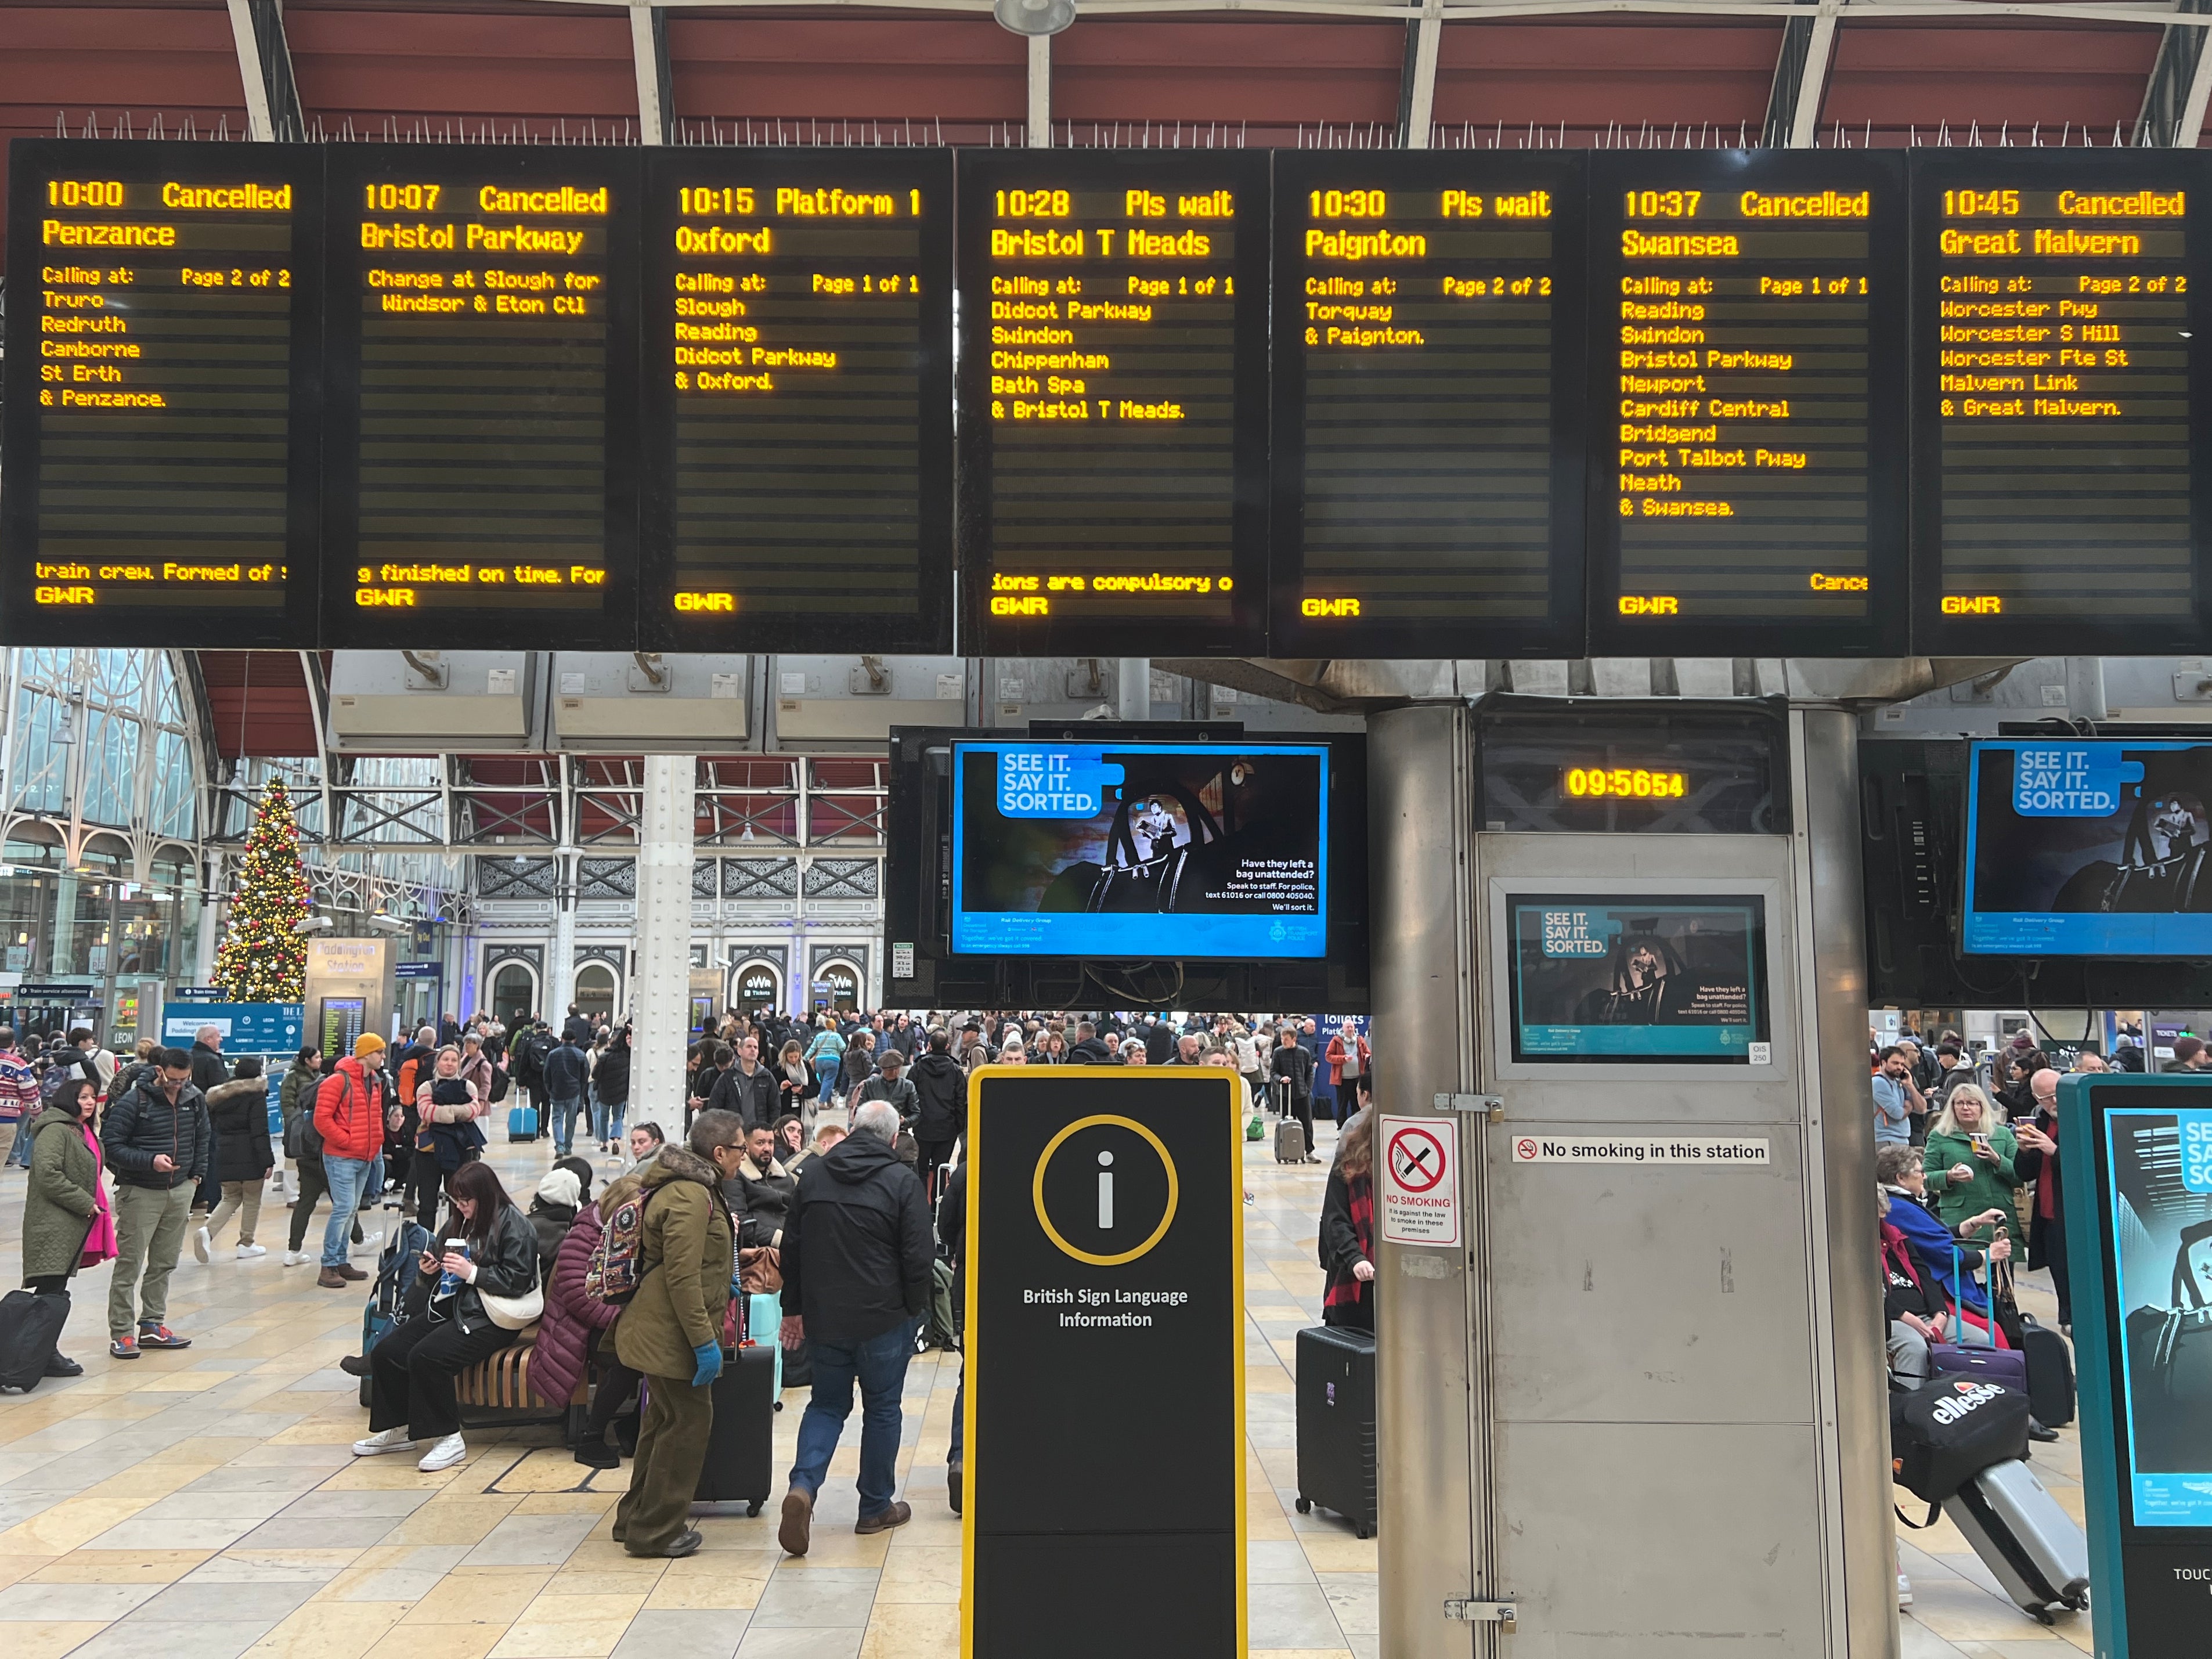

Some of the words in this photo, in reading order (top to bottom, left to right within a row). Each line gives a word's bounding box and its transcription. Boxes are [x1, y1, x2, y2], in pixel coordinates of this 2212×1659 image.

[49, 181, 124, 207] 10:00
[163, 182, 291, 209] Cancelled
[366, 185, 440, 210] 10:07
[480, 186, 607, 214] Cancelled
[680, 188, 755, 215] 10:15
[777, 188, 894, 216] Platform
[910, 189, 919, 215] 1
[997, 190, 1070, 217] 10:28
[1127, 190, 1166, 217] Pls
[1179, 190, 1234, 217] wait
[1945, 190, 2019, 216] 10:45
[1310, 190, 1385, 218] 10:30
[1442, 190, 1482, 218] Pls
[1495, 191, 1551, 218] wait
[1627, 191, 1701, 217] 10:37
[1741, 191, 1869, 217] Cancelled
[2059, 191, 2185, 217] Cancelled
[43, 220, 175, 246] Penzance
[362, 223, 454, 249] Bristol
[467, 224, 583, 254] Parkway
[676, 226, 771, 254] Oxford
[1940, 229, 2021, 254] Great
[2034, 229, 2140, 255] Malvern
[992, 229, 1084, 257] Bristol
[1096, 229, 1114, 255] T
[1128, 229, 1210, 257] Meads
[1306, 230, 1426, 260] Paignton
[1622, 230, 1739, 257] Swansea
[42, 267, 100, 285] Calling
[108, 268, 133, 283] at:
[182, 268, 223, 287] Page
[232, 269, 242, 285] 2
[250, 270, 270, 286] of
[279, 269, 290, 287] 2
[369, 270, 443, 288] Change
[452, 271, 475, 288] at
[485, 271, 555, 291] Slough
[564, 272, 600, 290] for
[43, 291, 104, 308] Truro
[383, 294, 465, 312] Windsor
[474, 295, 488, 312] &
[496, 295, 546, 314] Eton
[1941, 301, 2050, 318] Worcester
[2059, 301, 2098, 318] Pwy
[42, 316, 125, 333] Redruth
[41, 341, 140, 357] Camborne
[41, 365, 63, 381] St
[73, 365, 121, 381] Erth
[1941, 374, 2025, 391] Malvern
[2034, 374, 2079, 391] Link
[1621, 400, 1699, 418] Cardiff
[1709, 399, 1789, 417] Central
[1621, 424, 1716, 443] Bridgend
[36, 562, 90, 579] train
[99, 567, 154, 579] crew.
[164, 563, 239, 580] Formed
[248, 564, 273, 580] of
[380, 564, 471, 582] finished
[478, 569, 505, 582] on
[514, 566, 562, 583] time.
[571, 567, 605, 583] For
[992, 574, 1039, 590] ions
[1047, 577, 1085, 590] are
[1093, 574, 1211, 593] compulsory
[1219, 577, 1233, 590] o
[35, 587, 94, 604] GWR
[1942, 597, 2000, 614] GWR
[1004, 754, 1043, 771] SEE
[1049, 755, 1070, 771] IT.
[2021, 752, 2061, 769] SEE
[2066, 752, 2089, 769] IT.
[1004, 773, 1043, 790] SAY
[1049, 774, 1070, 791] IT.
[2020, 771, 2061, 789] SAY
[2066, 772, 2088, 789] IT.
[1004, 793, 1096, 810] SORTED.
[2019, 791, 2115, 809] SORTED.
[1242, 859, 1265, 868] Have
[1266, 859, 1289, 870] they
[1289, 859, 1307, 868] left
[1236, 870, 1254, 880] bag
[1254, 870, 1315, 879] unattended?
[1226, 882, 1249, 890] Speak
[1291, 883, 1315, 892] police,
[1546, 913, 1570, 925] SEE
[1574, 913, 1588, 925] IT.
[1546, 926, 1571, 939] SAY
[1574, 926, 1588, 939] IT.
[1546, 940, 1605, 953] SORTED.
[327, 961, 365, 972] Station
[746, 975, 771, 989] GWR
[114, 1033, 133, 1044] LEON
[1543, 1142, 1566, 1157] No
[1572, 1143, 1644, 1160] smoking
[1650, 1144, 1665, 1157] in
[1669, 1144, 1701, 1158] this
[1706, 1144, 1764, 1158] station
[1387, 1194, 1398, 1204] NO
[1401, 1196, 1450, 1207] SMOKING
[1024, 1288, 1073, 1304] British
[1078, 1289, 1110, 1307] Sign
[1115, 1289, 1188, 1306] Language
[1060, 1312, 1152, 1327] Information
[1932, 1379, 2007, 1426] ellesse
[2173, 1568, 2212, 1580] TOUC
